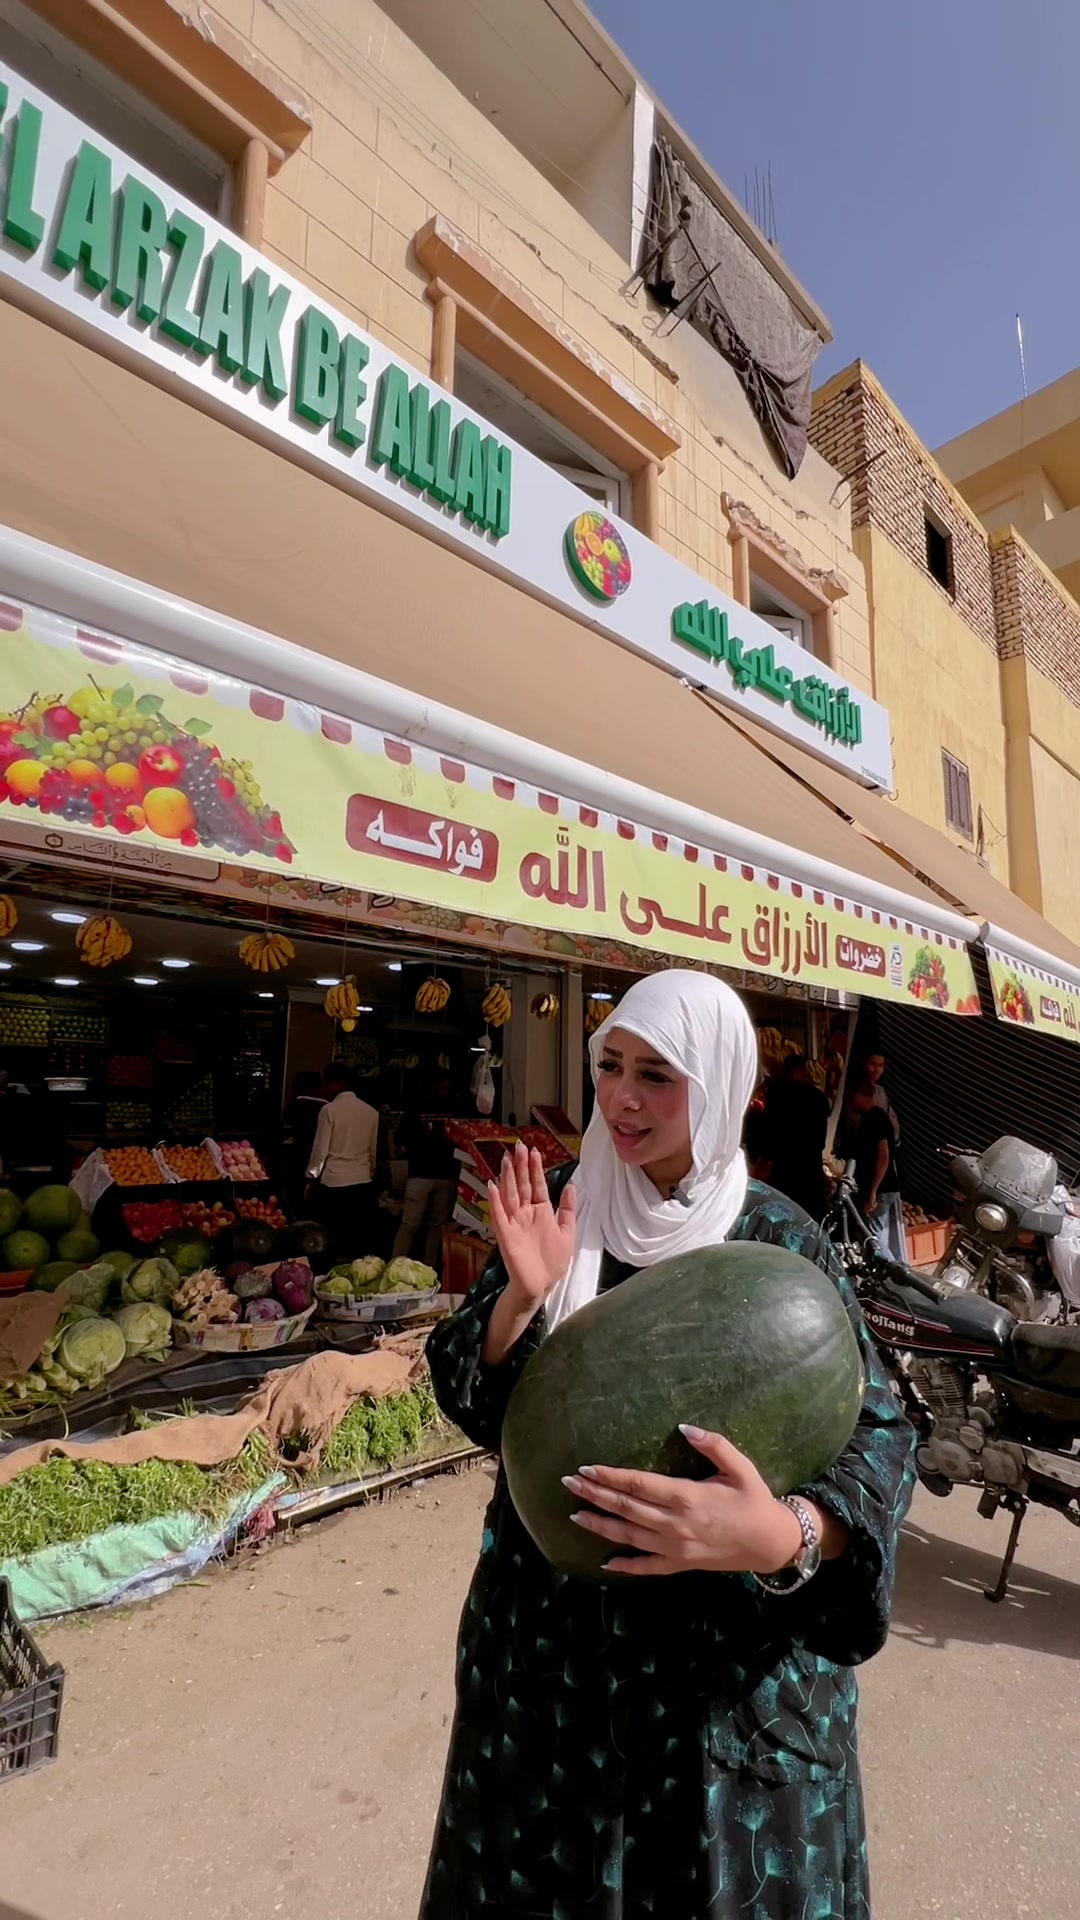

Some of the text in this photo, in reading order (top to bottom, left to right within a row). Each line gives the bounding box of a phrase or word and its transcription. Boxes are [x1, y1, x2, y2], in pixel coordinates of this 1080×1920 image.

[0, 80, 512, 540] L ARZAK BE ALLAH
[673, 599, 731, 662] الله
[365, 809, 484, 876] فواكه
[519, 826, 606, 912] الله
[619, 882, 732, 944] على
[741, 904, 828, 976] الأرزاق
[840, 937, 882, 972] خضروات
